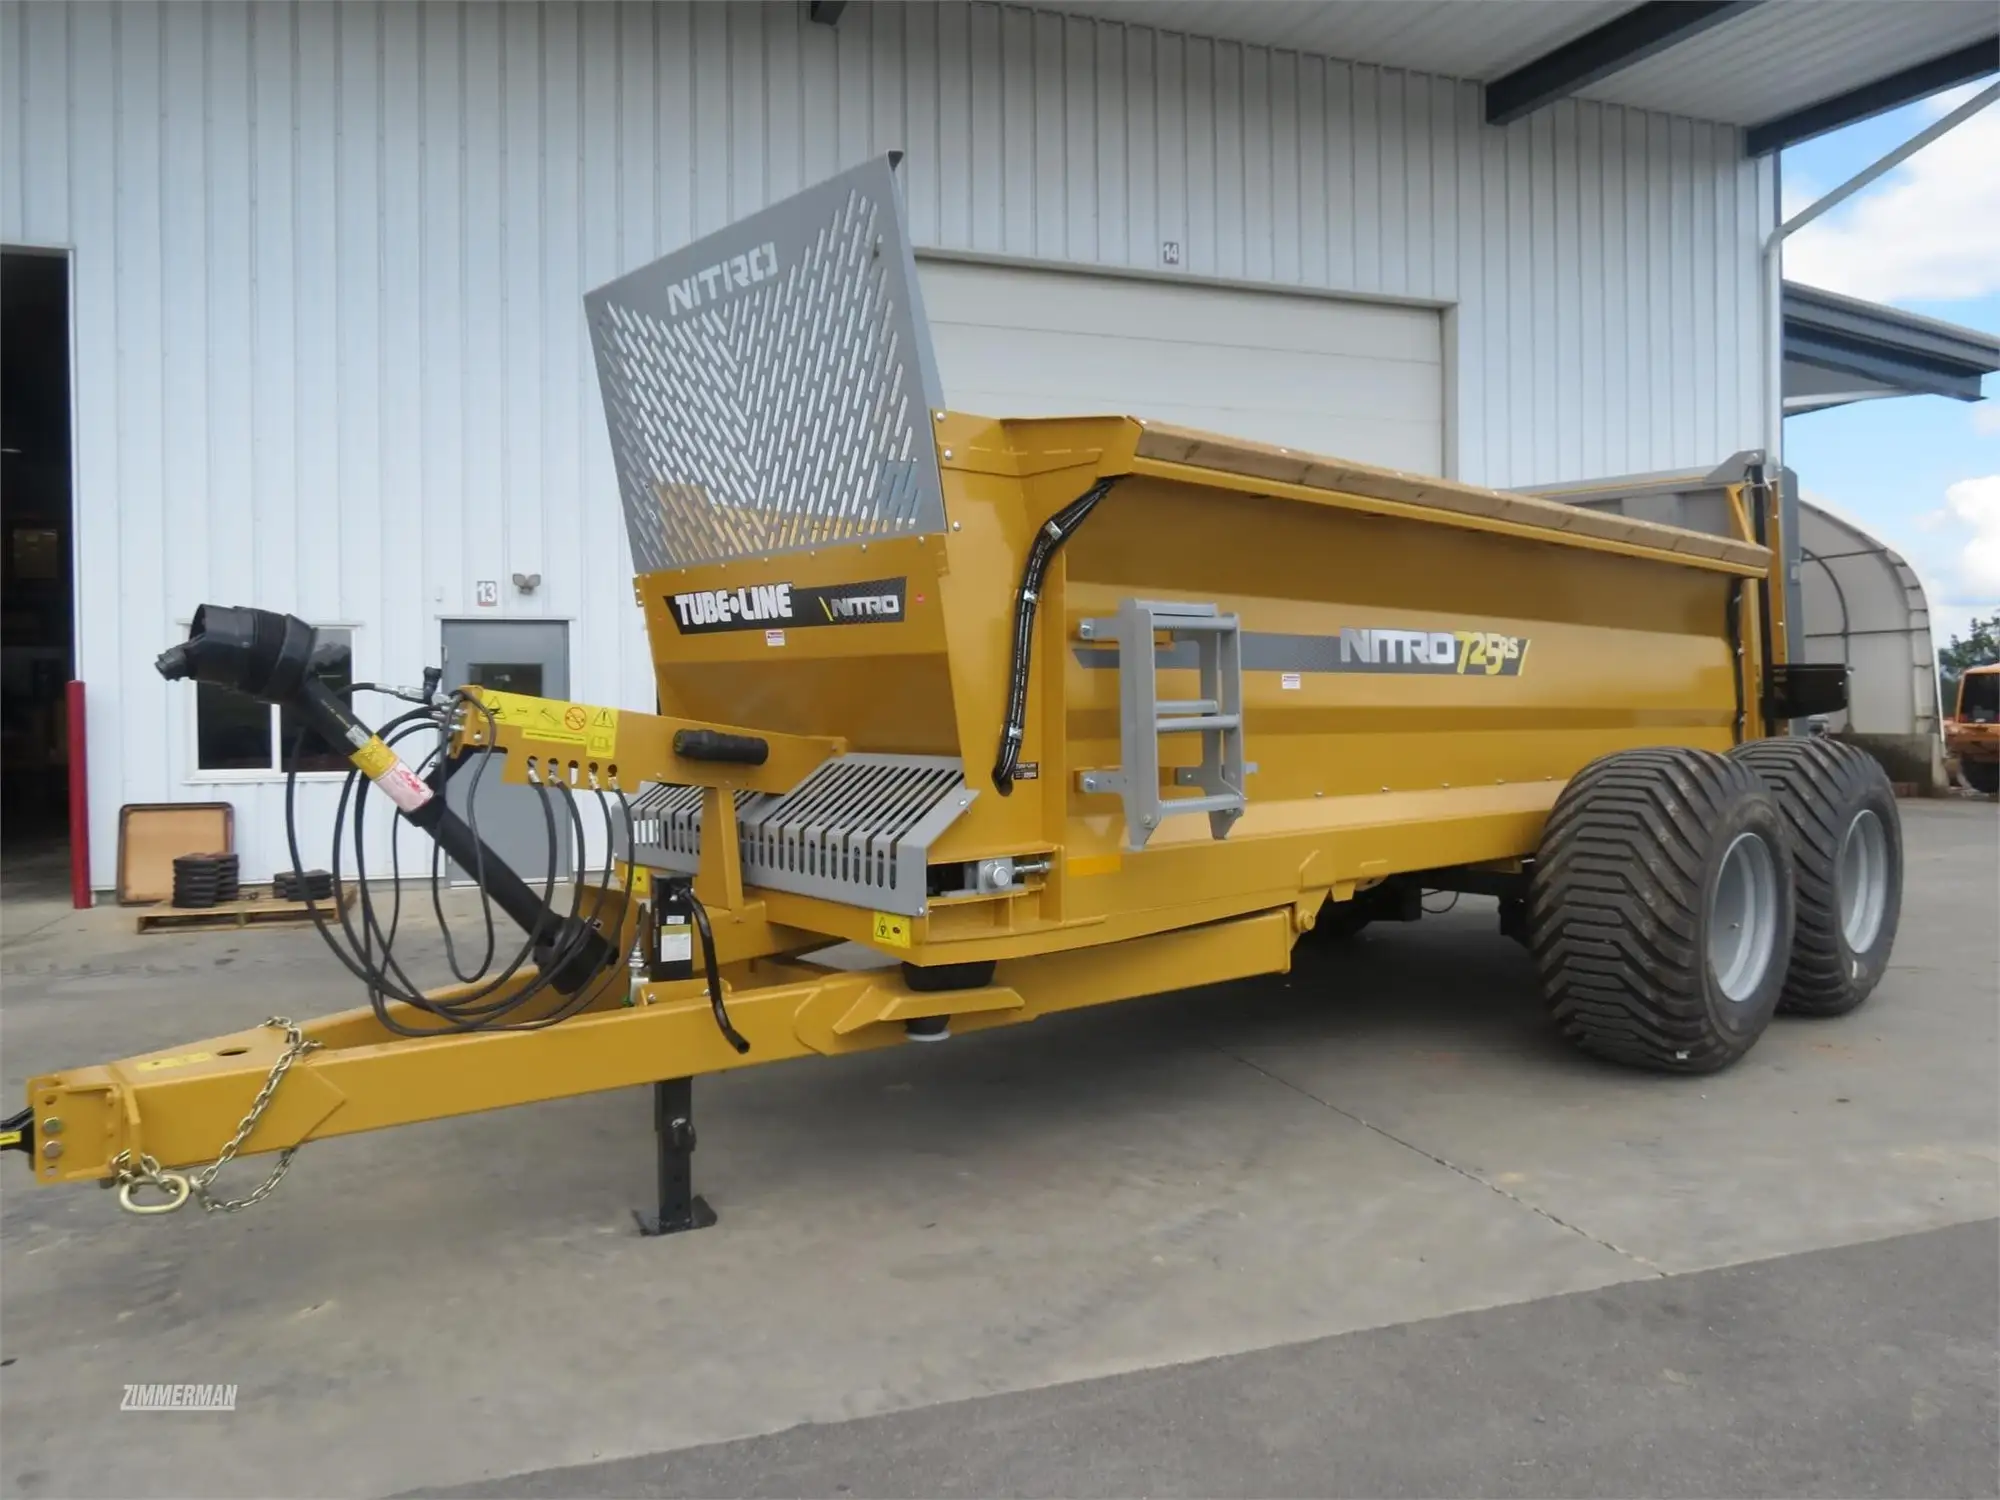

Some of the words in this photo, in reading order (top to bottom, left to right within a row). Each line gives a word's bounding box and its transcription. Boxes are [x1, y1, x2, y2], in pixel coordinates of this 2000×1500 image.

[1164, 244, 1178, 261] 14
[666, 241, 779, 316] NITRO
[478, 582, 496, 602] 13
[830, 595, 900, 617] NITRO
[1340, 628, 1456, 664] NITRO
